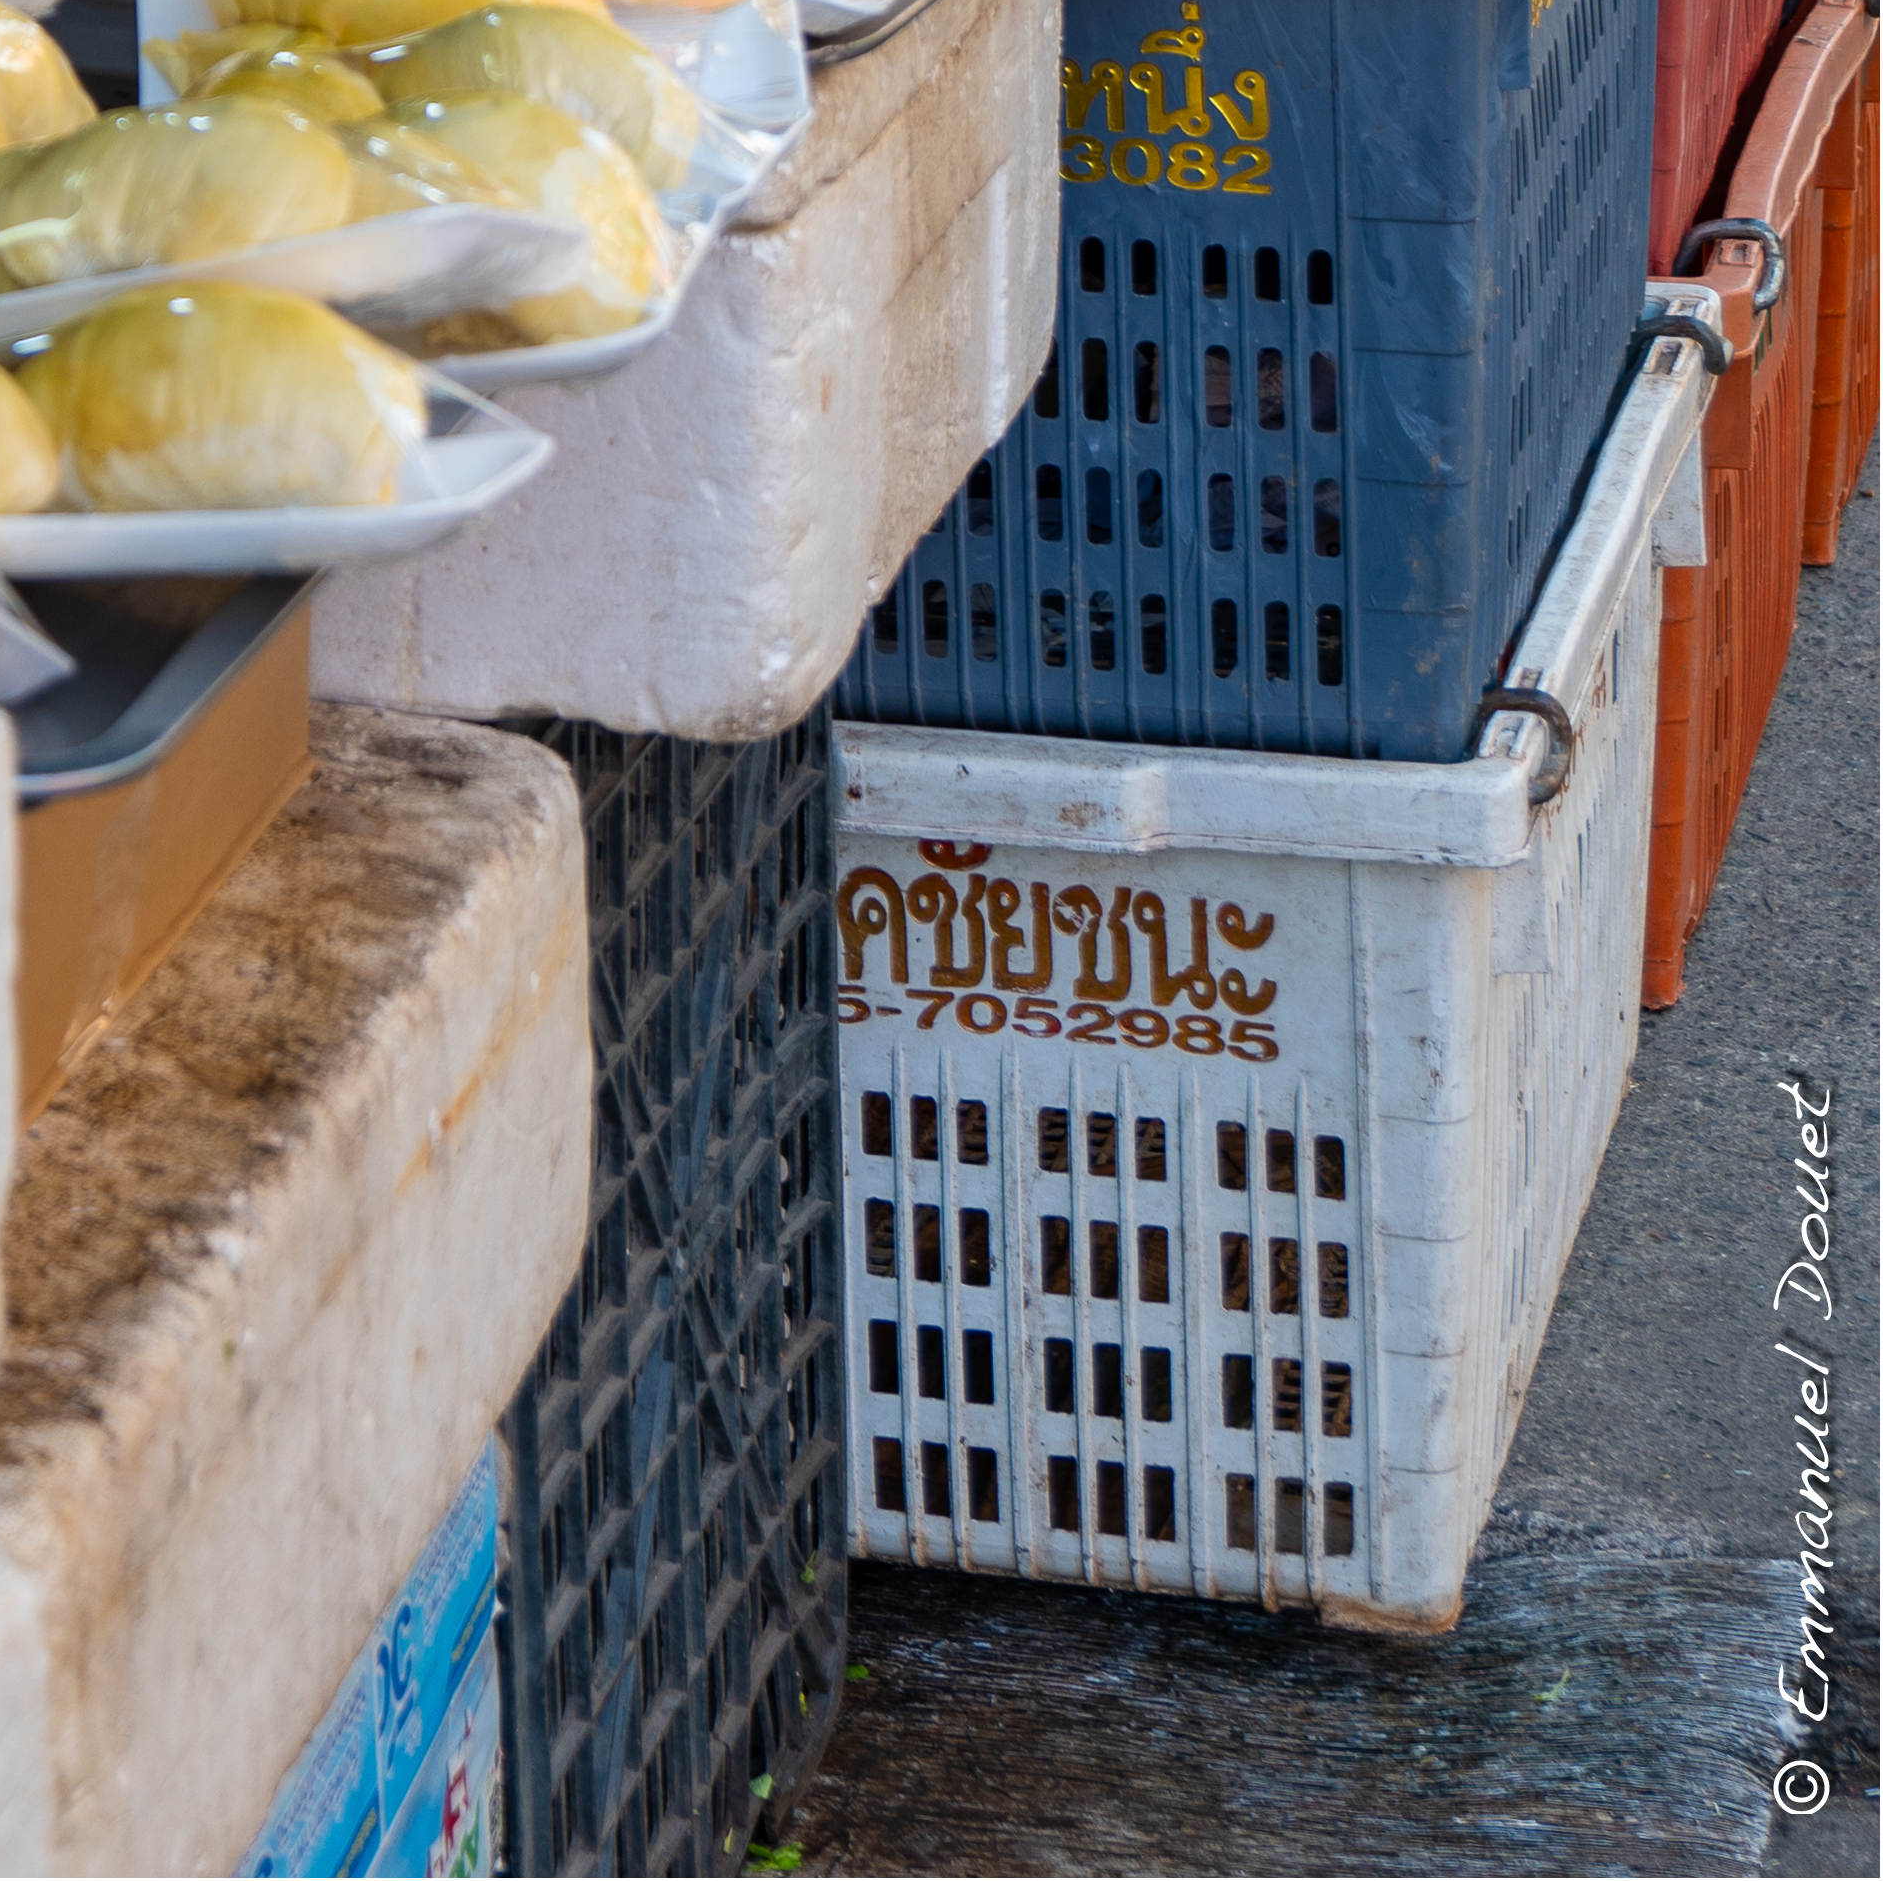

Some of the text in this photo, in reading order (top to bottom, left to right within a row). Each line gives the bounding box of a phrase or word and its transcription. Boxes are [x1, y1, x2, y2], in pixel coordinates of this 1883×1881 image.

[1059, 0, 1269, 141] หนึ่ง
[1059, 134, 1272, 195] 3082
[837, 984, 1279, 1063] 5-7052985
